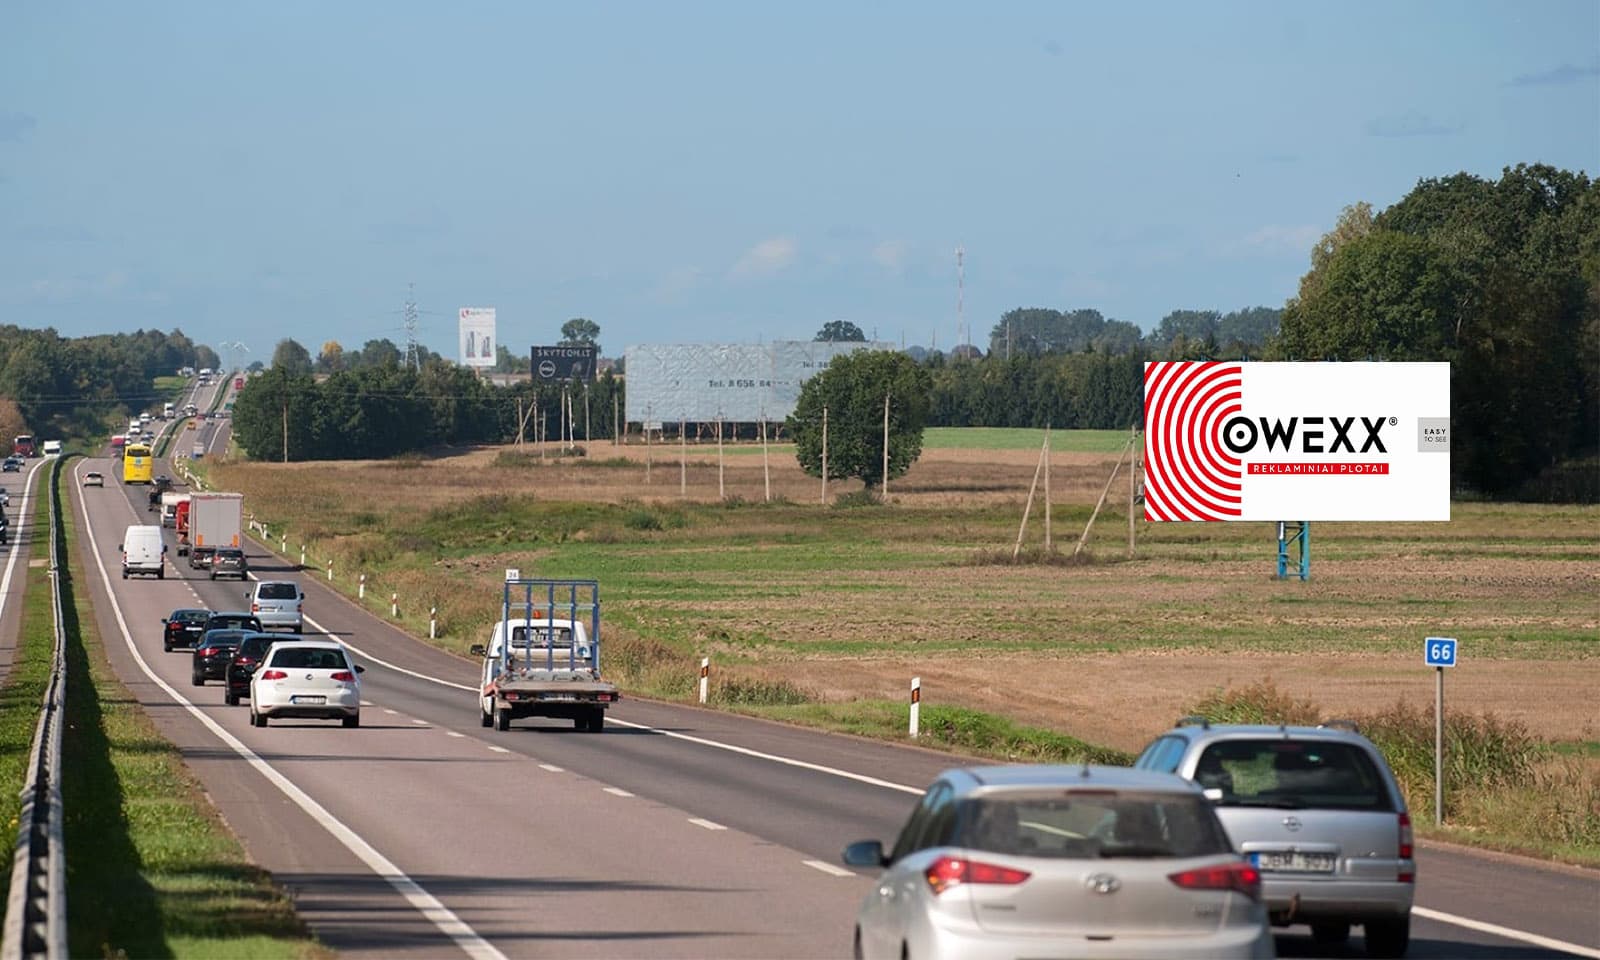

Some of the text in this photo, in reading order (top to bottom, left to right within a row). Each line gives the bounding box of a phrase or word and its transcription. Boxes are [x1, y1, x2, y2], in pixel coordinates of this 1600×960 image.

[1253, 464, 1384, 474] REKLAMINIAI PLOTAI
[1431, 644, 1451, 660] 66
